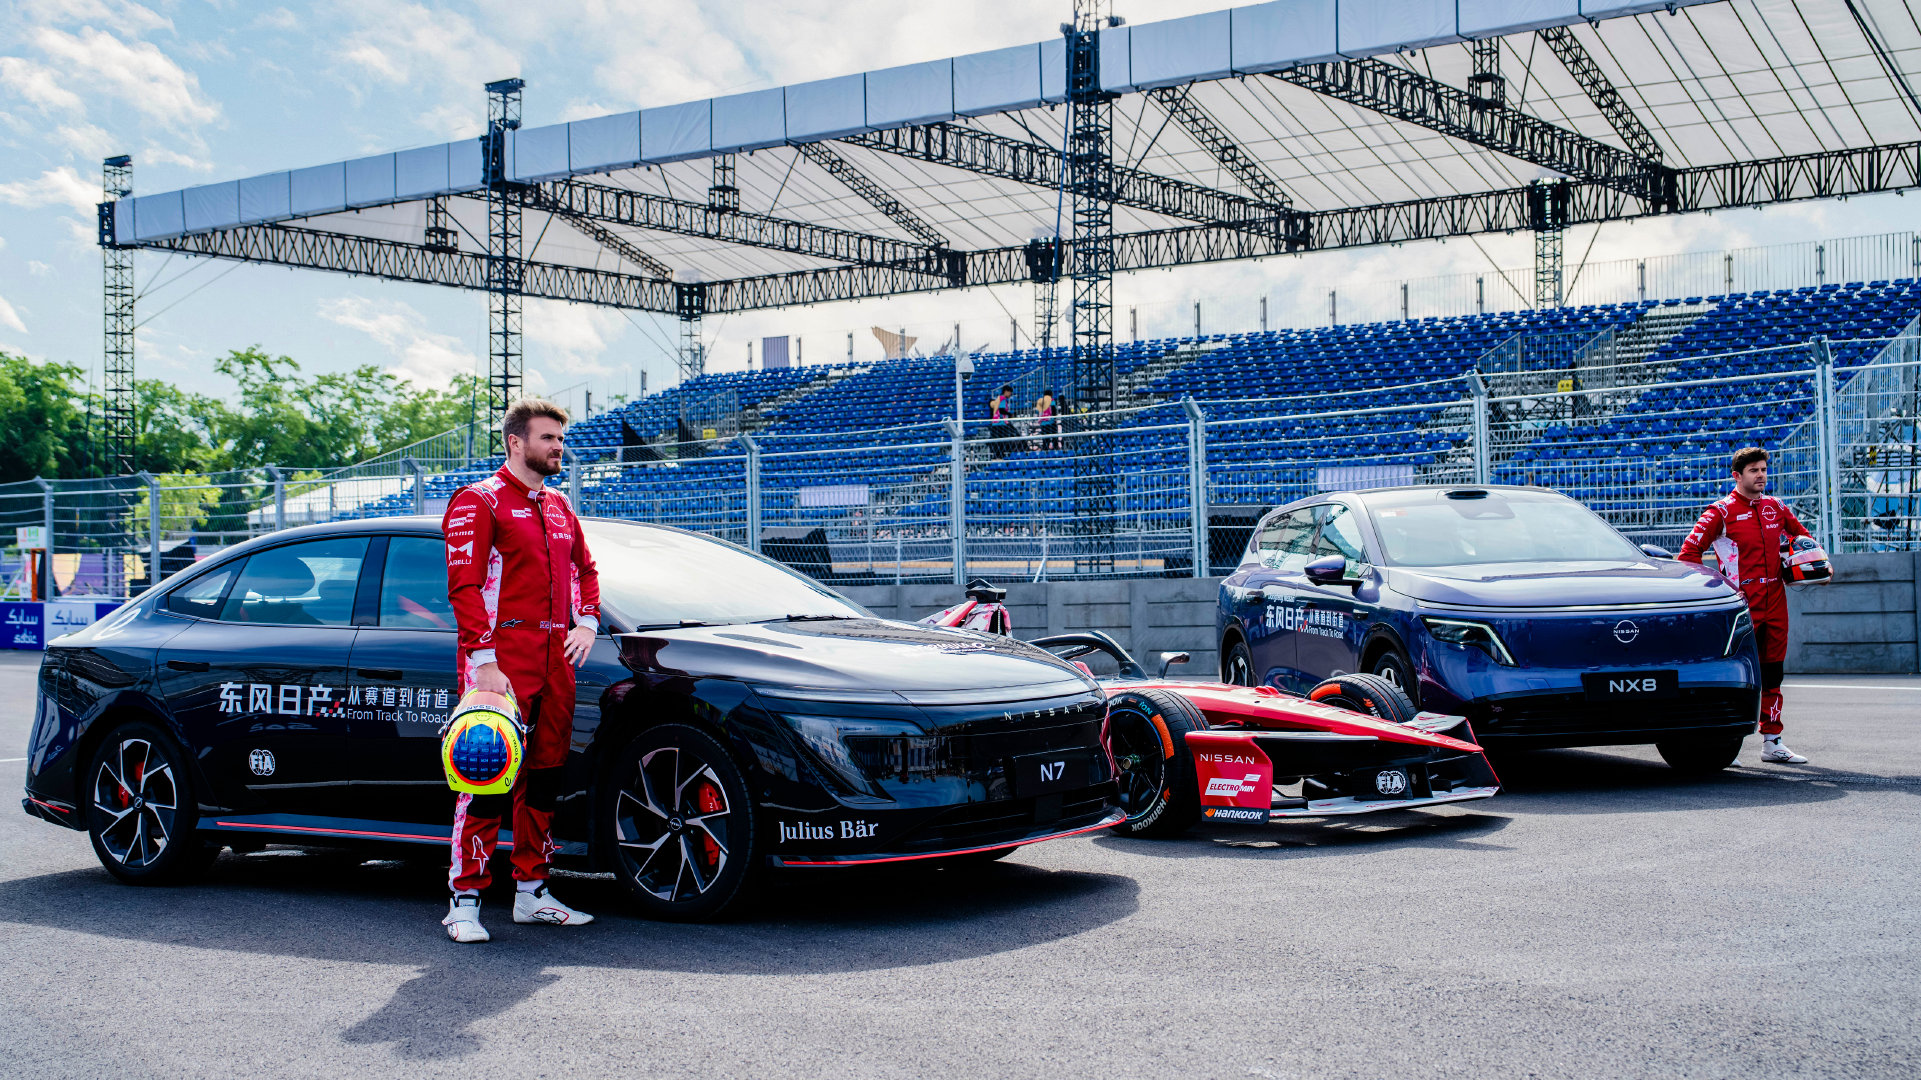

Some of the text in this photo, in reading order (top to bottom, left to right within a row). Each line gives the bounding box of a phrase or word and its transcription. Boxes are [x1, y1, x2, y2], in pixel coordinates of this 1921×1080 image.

[1265, 605, 1305, 631] 东风日产
[1609, 678, 1657, 692] NX8
[219, 682, 333, 716] 东风日产
[347, 685, 449, 709] 从赛道到街道
[347, 708, 449, 724] From Track To Road
[1004, 704, 1083, 720] NISSAN
[250, 754, 274, 773] FIA
[1200, 753, 1255, 765] NISSAN
[1040, 761, 1065, 782] N7
[1209, 783, 1255, 793] ELECTROMIN
[1377, 773, 1404, 792] FIA
[779, 819, 879, 843] Julius Bär
